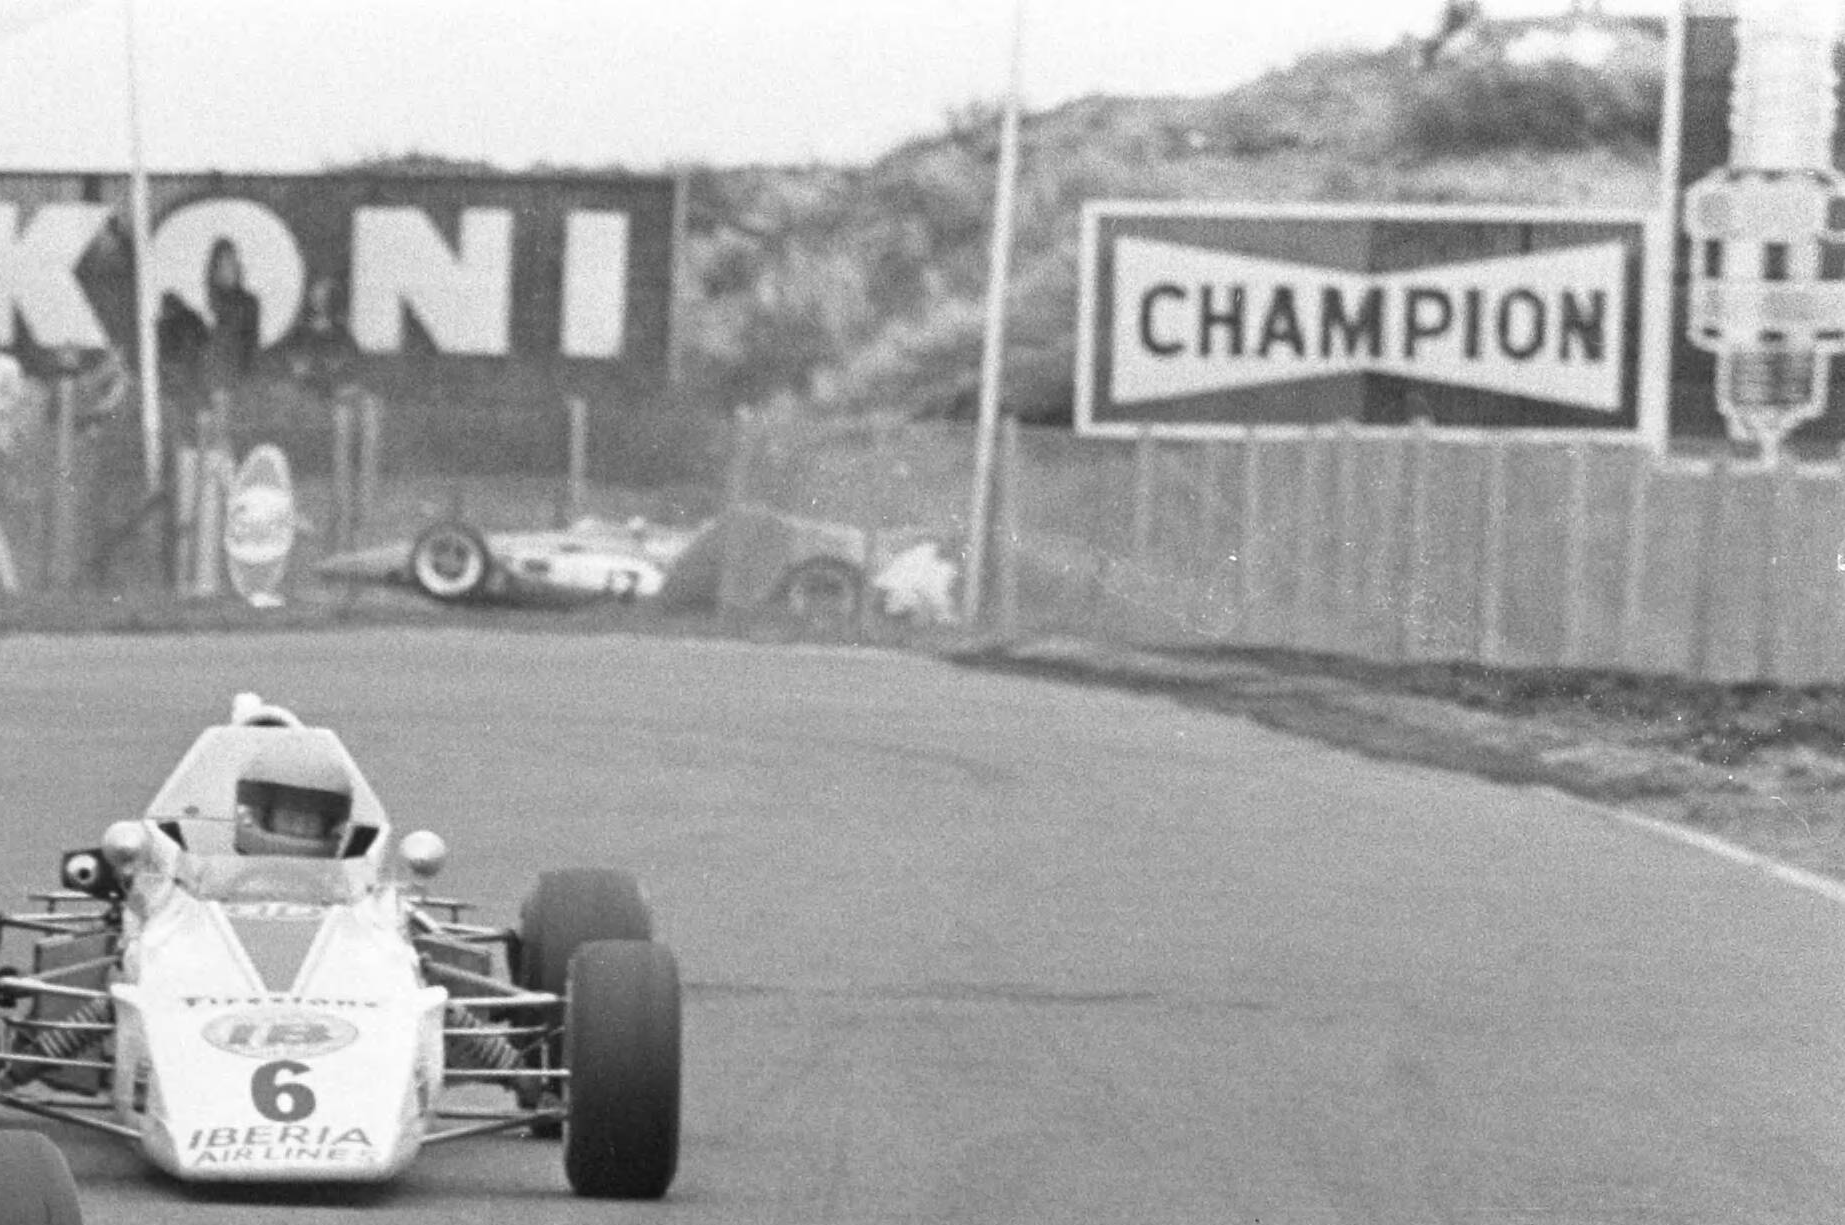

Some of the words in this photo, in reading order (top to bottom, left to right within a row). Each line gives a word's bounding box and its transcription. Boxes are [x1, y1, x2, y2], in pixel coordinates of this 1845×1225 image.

[1137, 285, 1605, 362] CHAMPION
[250, 1060, 317, 1124] 6
[189, 1125, 373, 1150] IBERIA
